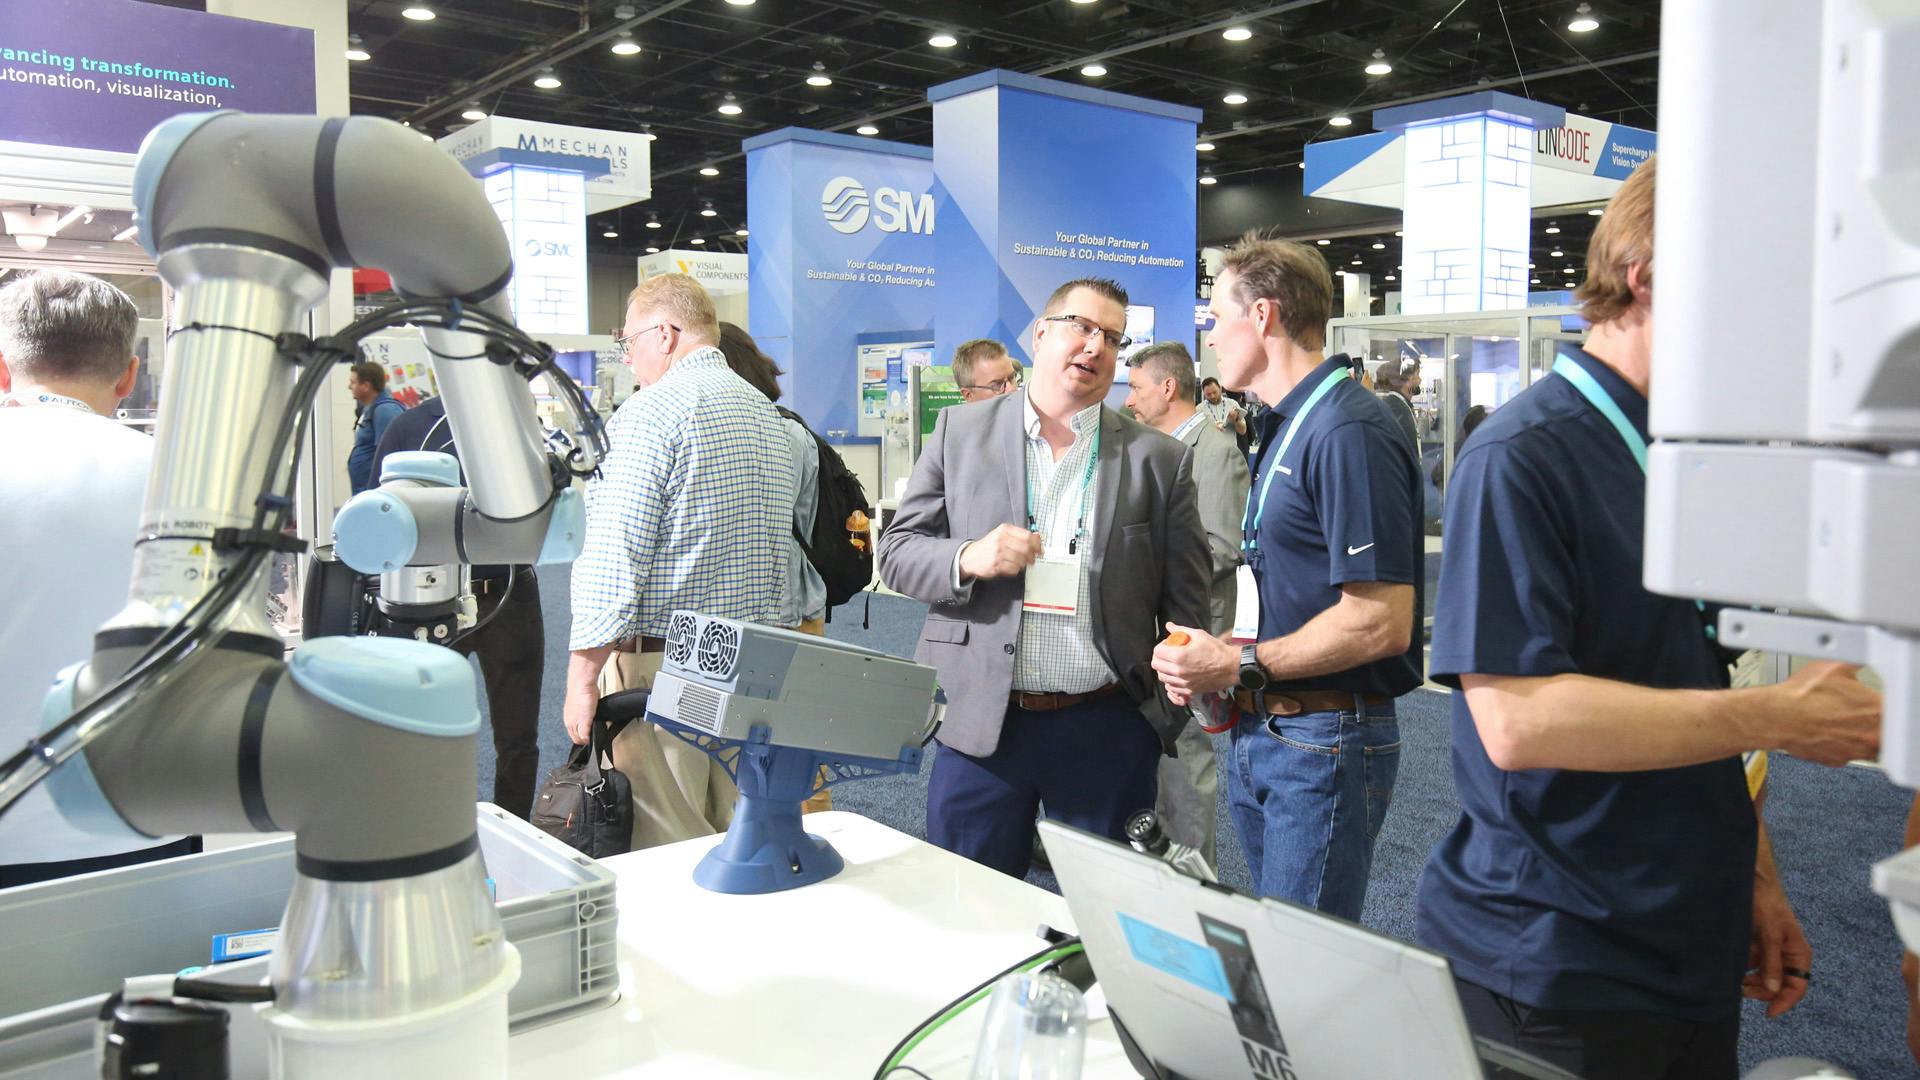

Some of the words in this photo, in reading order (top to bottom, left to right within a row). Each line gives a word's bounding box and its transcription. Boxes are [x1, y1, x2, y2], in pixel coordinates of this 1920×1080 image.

[81, 56, 235, 89] transformation.
[106, 80, 222, 108] visualization,
[543, 137, 627, 156] MECHAN
[1537, 127, 1591, 163] LINCODE
[1612, 142, 1648, 160] Supercharge
[1612, 155, 1630, 167] Vision
[873, 187, 934, 235] SM
[1056, 231, 1077, 243] Your
[1078, 233, 1106, 247] Global
[1107, 236, 1140, 250] Partner
[1141, 239, 1149, 251] in
[1014, 243, 1067, 258] Sustainable
[1070, 249, 1076, 258] &
[1097, 250, 1136, 266] Reducing
[1138, 254, 1184, 268] Automation
[696, 262, 723, 271] VISUAL
[696, 271, 749, 280] COMPONENTS
[847, 259, 865, 269] Your
[867, 261, 894, 272] Global
[895, 263, 926, 274] Partner
[927, 265, 935, 275] in
[807, 269, 857, 281] Sustainable
[859, 273, 865, 281] &
[885, 275, 923, 288] Reducing
[924, 277, 935, 287] Au
